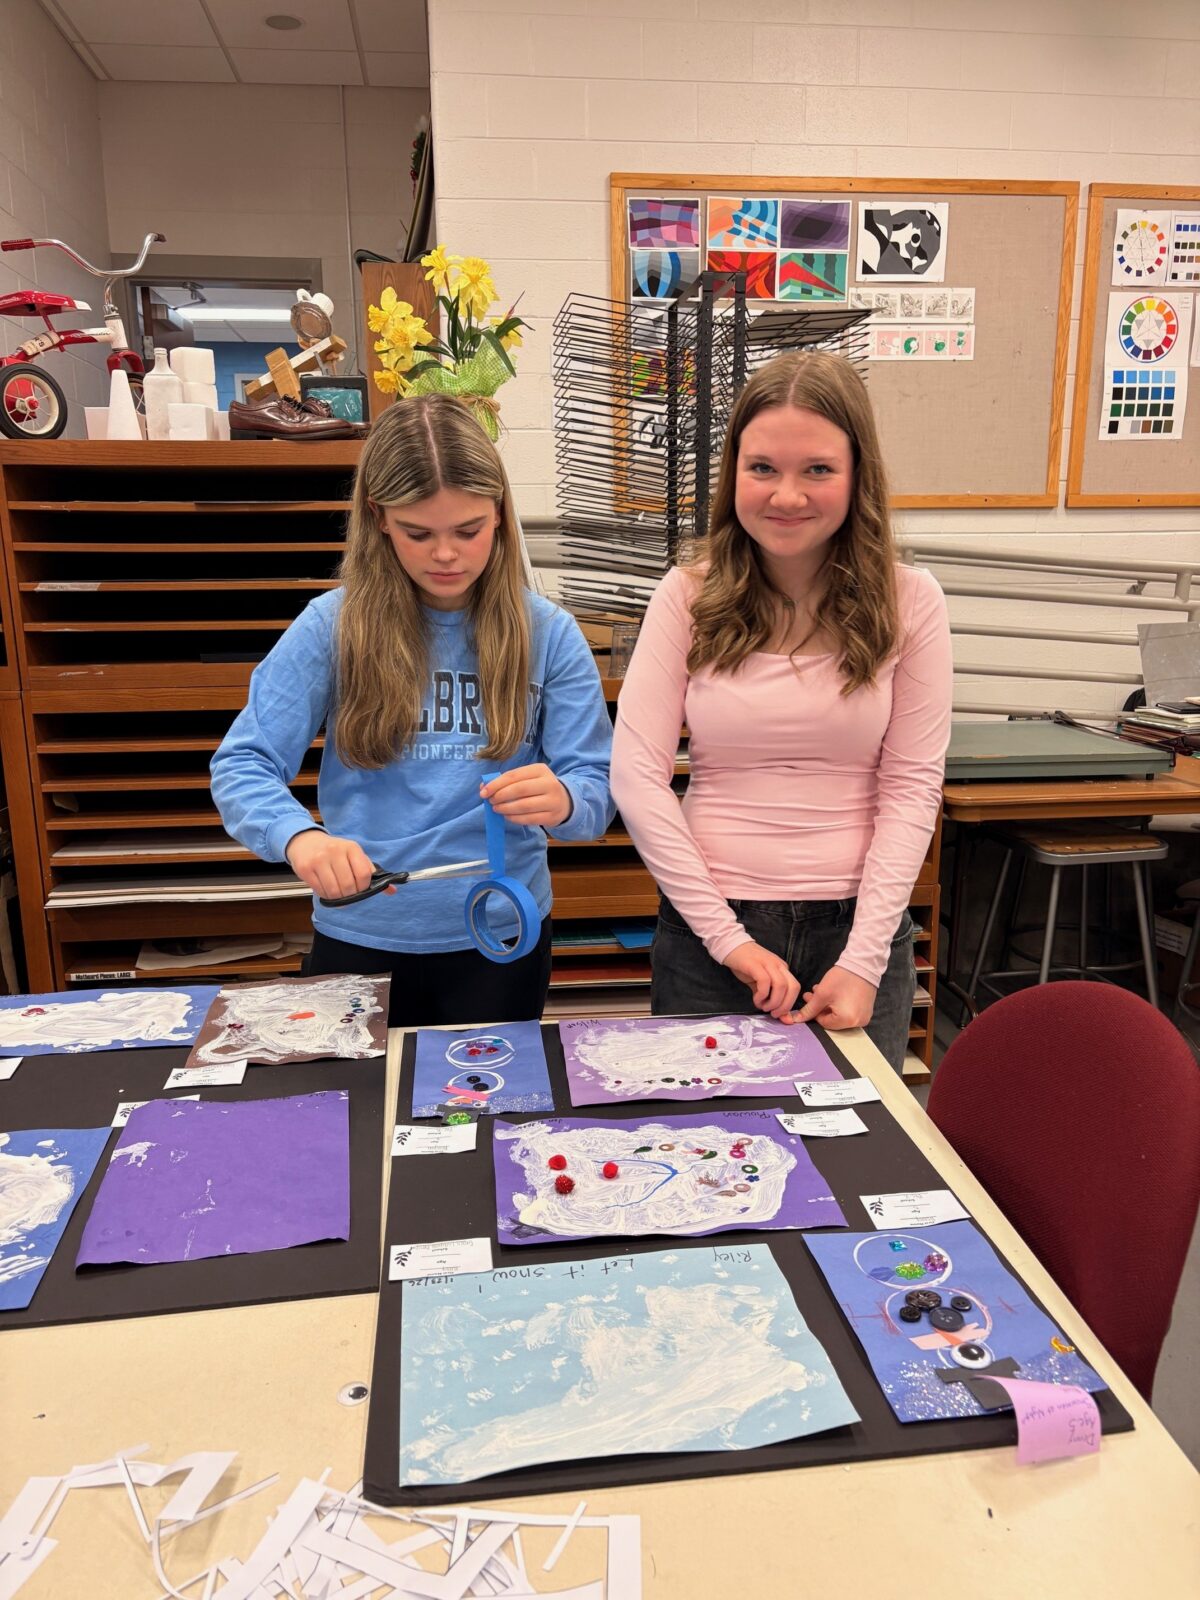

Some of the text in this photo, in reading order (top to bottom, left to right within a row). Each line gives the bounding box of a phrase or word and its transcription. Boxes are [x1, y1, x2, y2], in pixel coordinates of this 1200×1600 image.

[713, 1245, 752, 1263] Riley
[561, 1264, 586, 1280] it
[600, 1258, 634, 1274] Let
